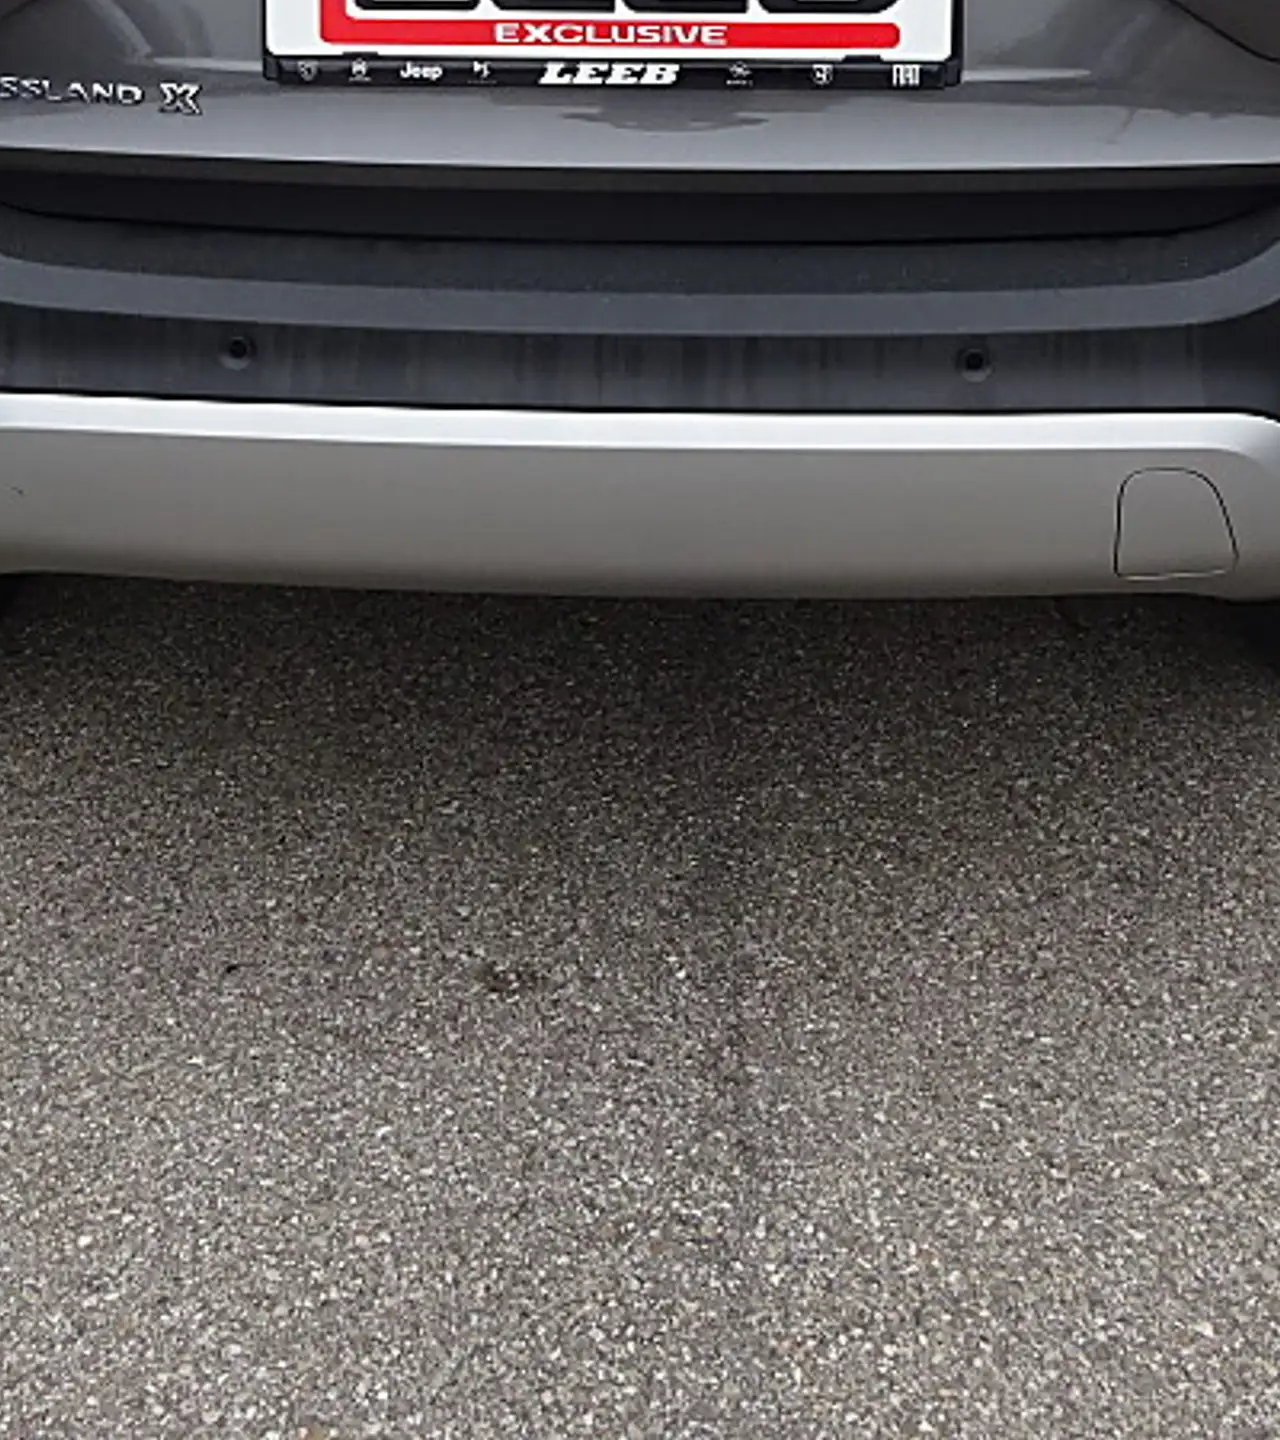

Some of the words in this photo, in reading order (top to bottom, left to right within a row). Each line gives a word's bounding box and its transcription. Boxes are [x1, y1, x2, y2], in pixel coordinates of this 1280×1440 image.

[493, 22, 729, 46] EXCLUSIVE
[399, 61, 443, 81] Jeep
[538, 61, 681, 86] LEEB
[158, 81, 203, 116] X
